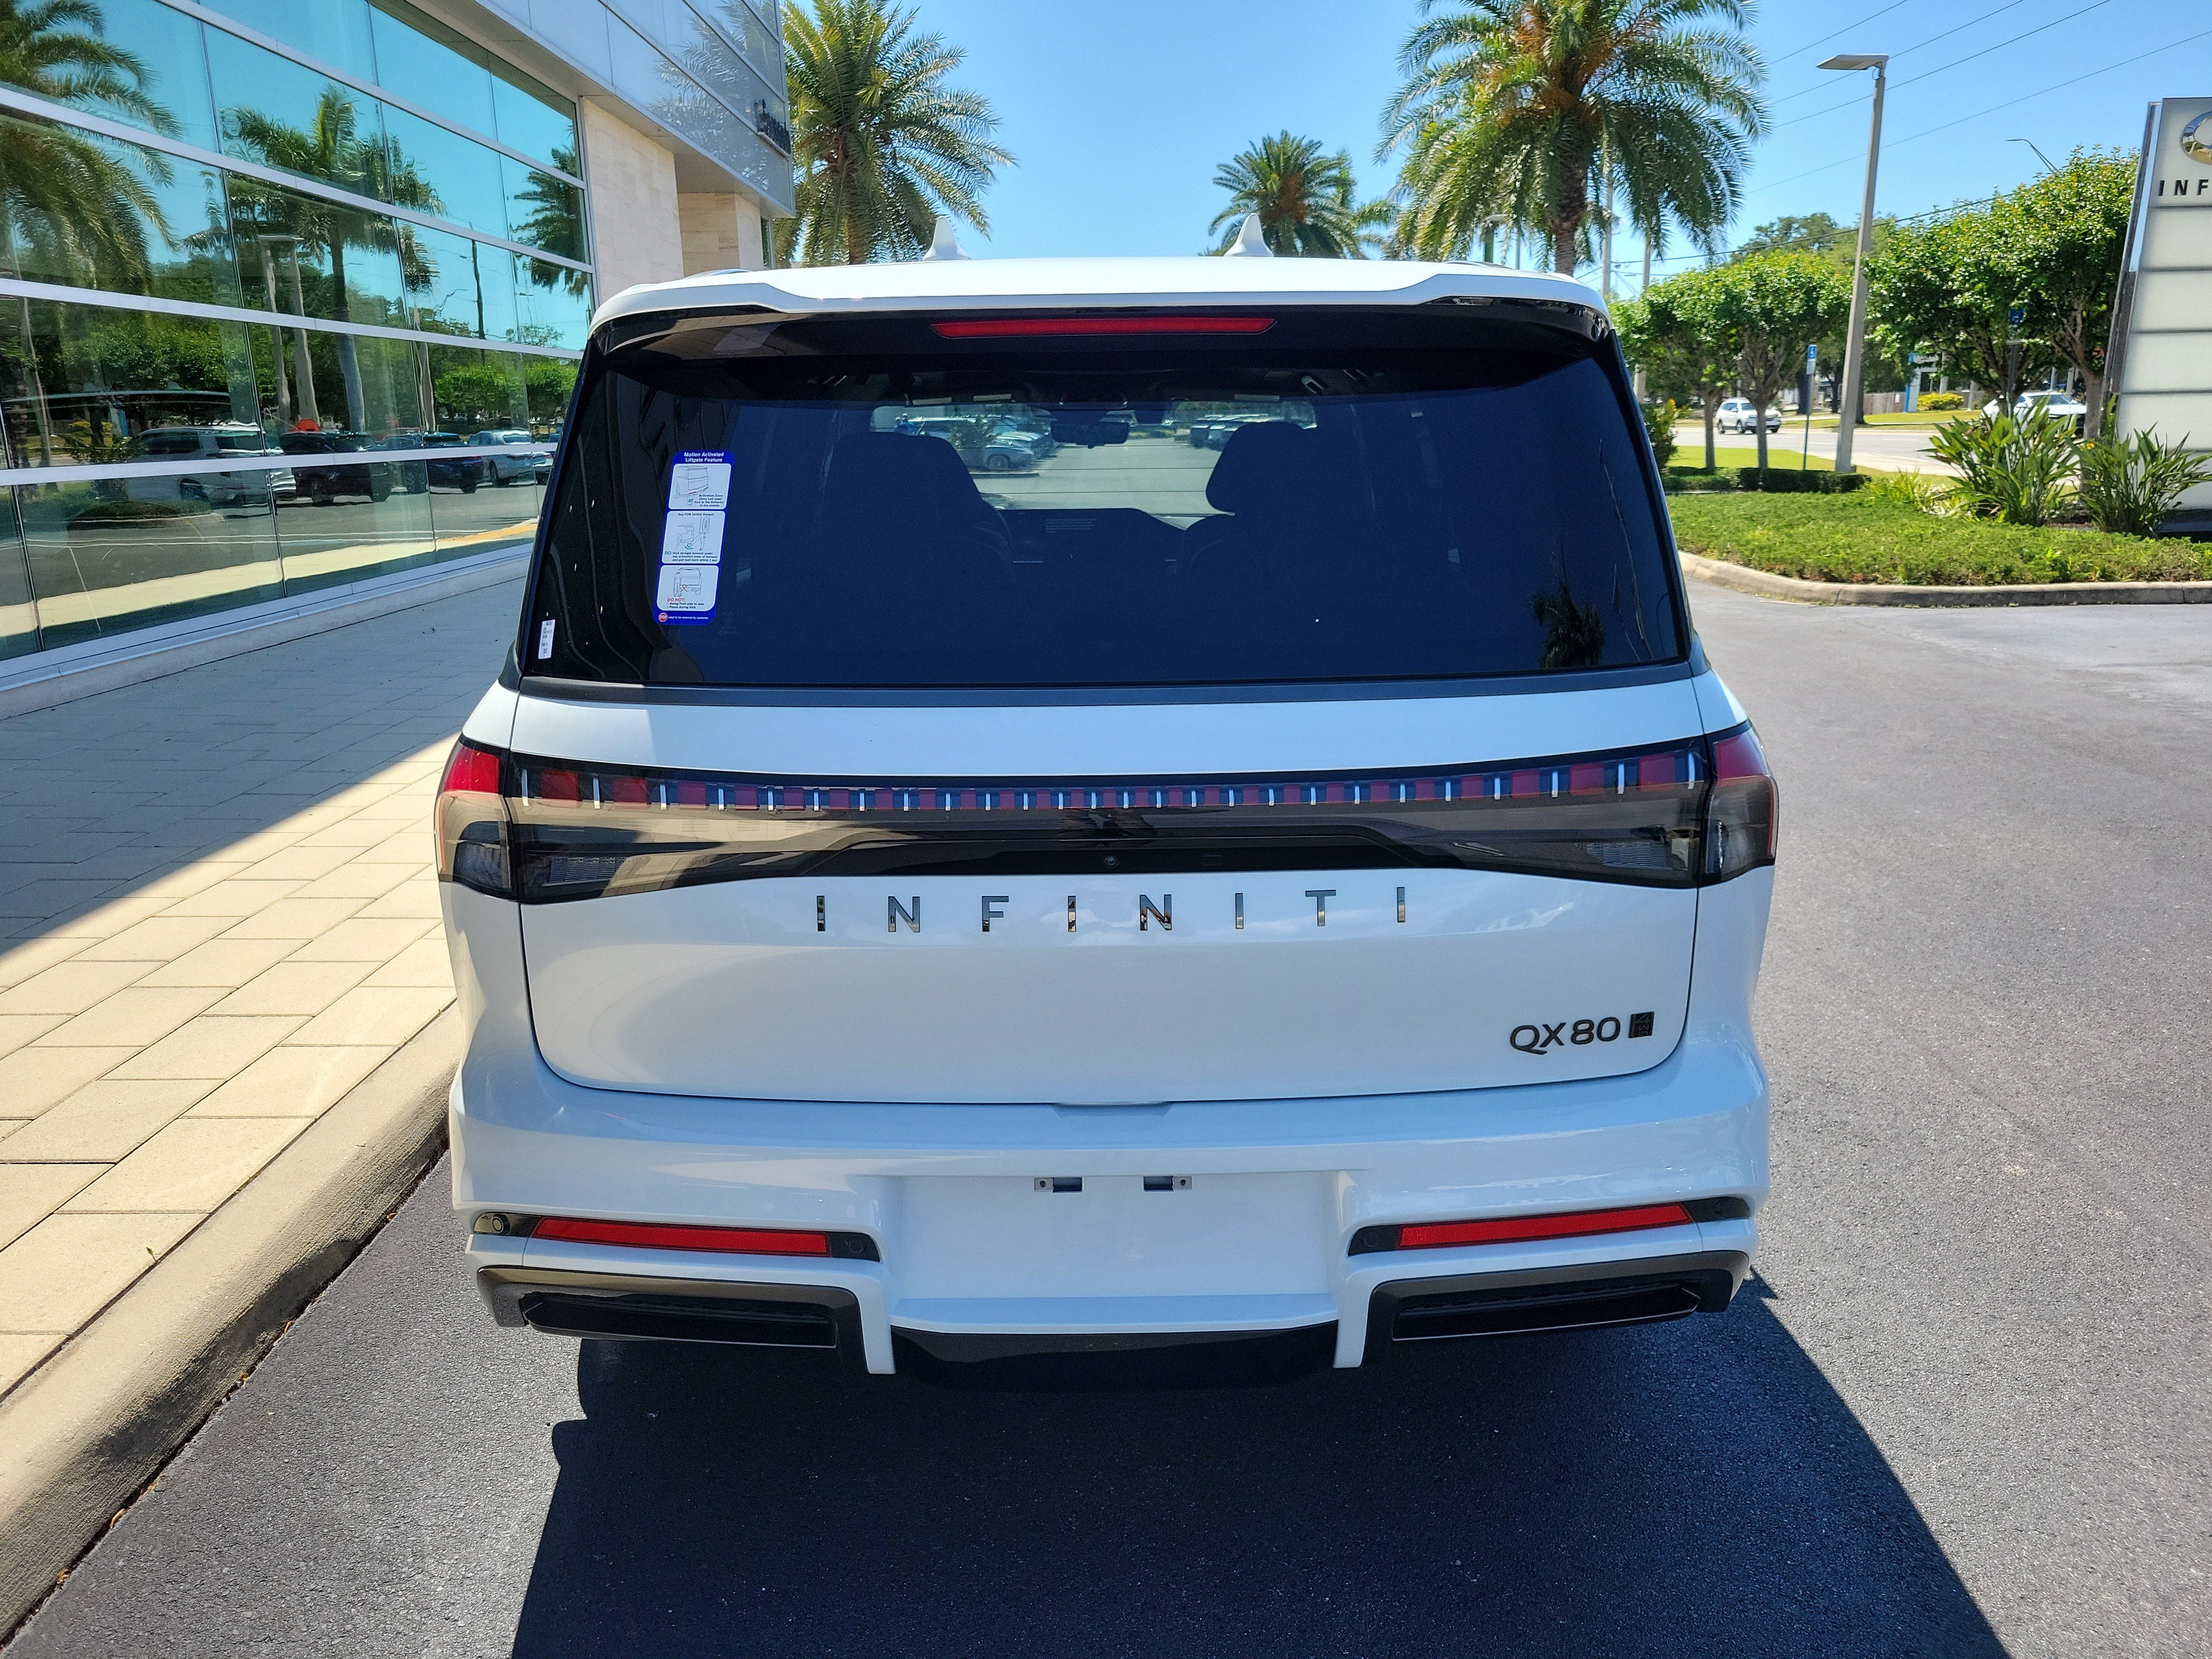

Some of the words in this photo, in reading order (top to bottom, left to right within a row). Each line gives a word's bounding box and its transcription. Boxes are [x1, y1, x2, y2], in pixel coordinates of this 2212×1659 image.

[2158, 179, 2209, 196] INF
[816, 887, 1406, 933] INFINITI
[1509, 1017, 1621, 1055] QX80
